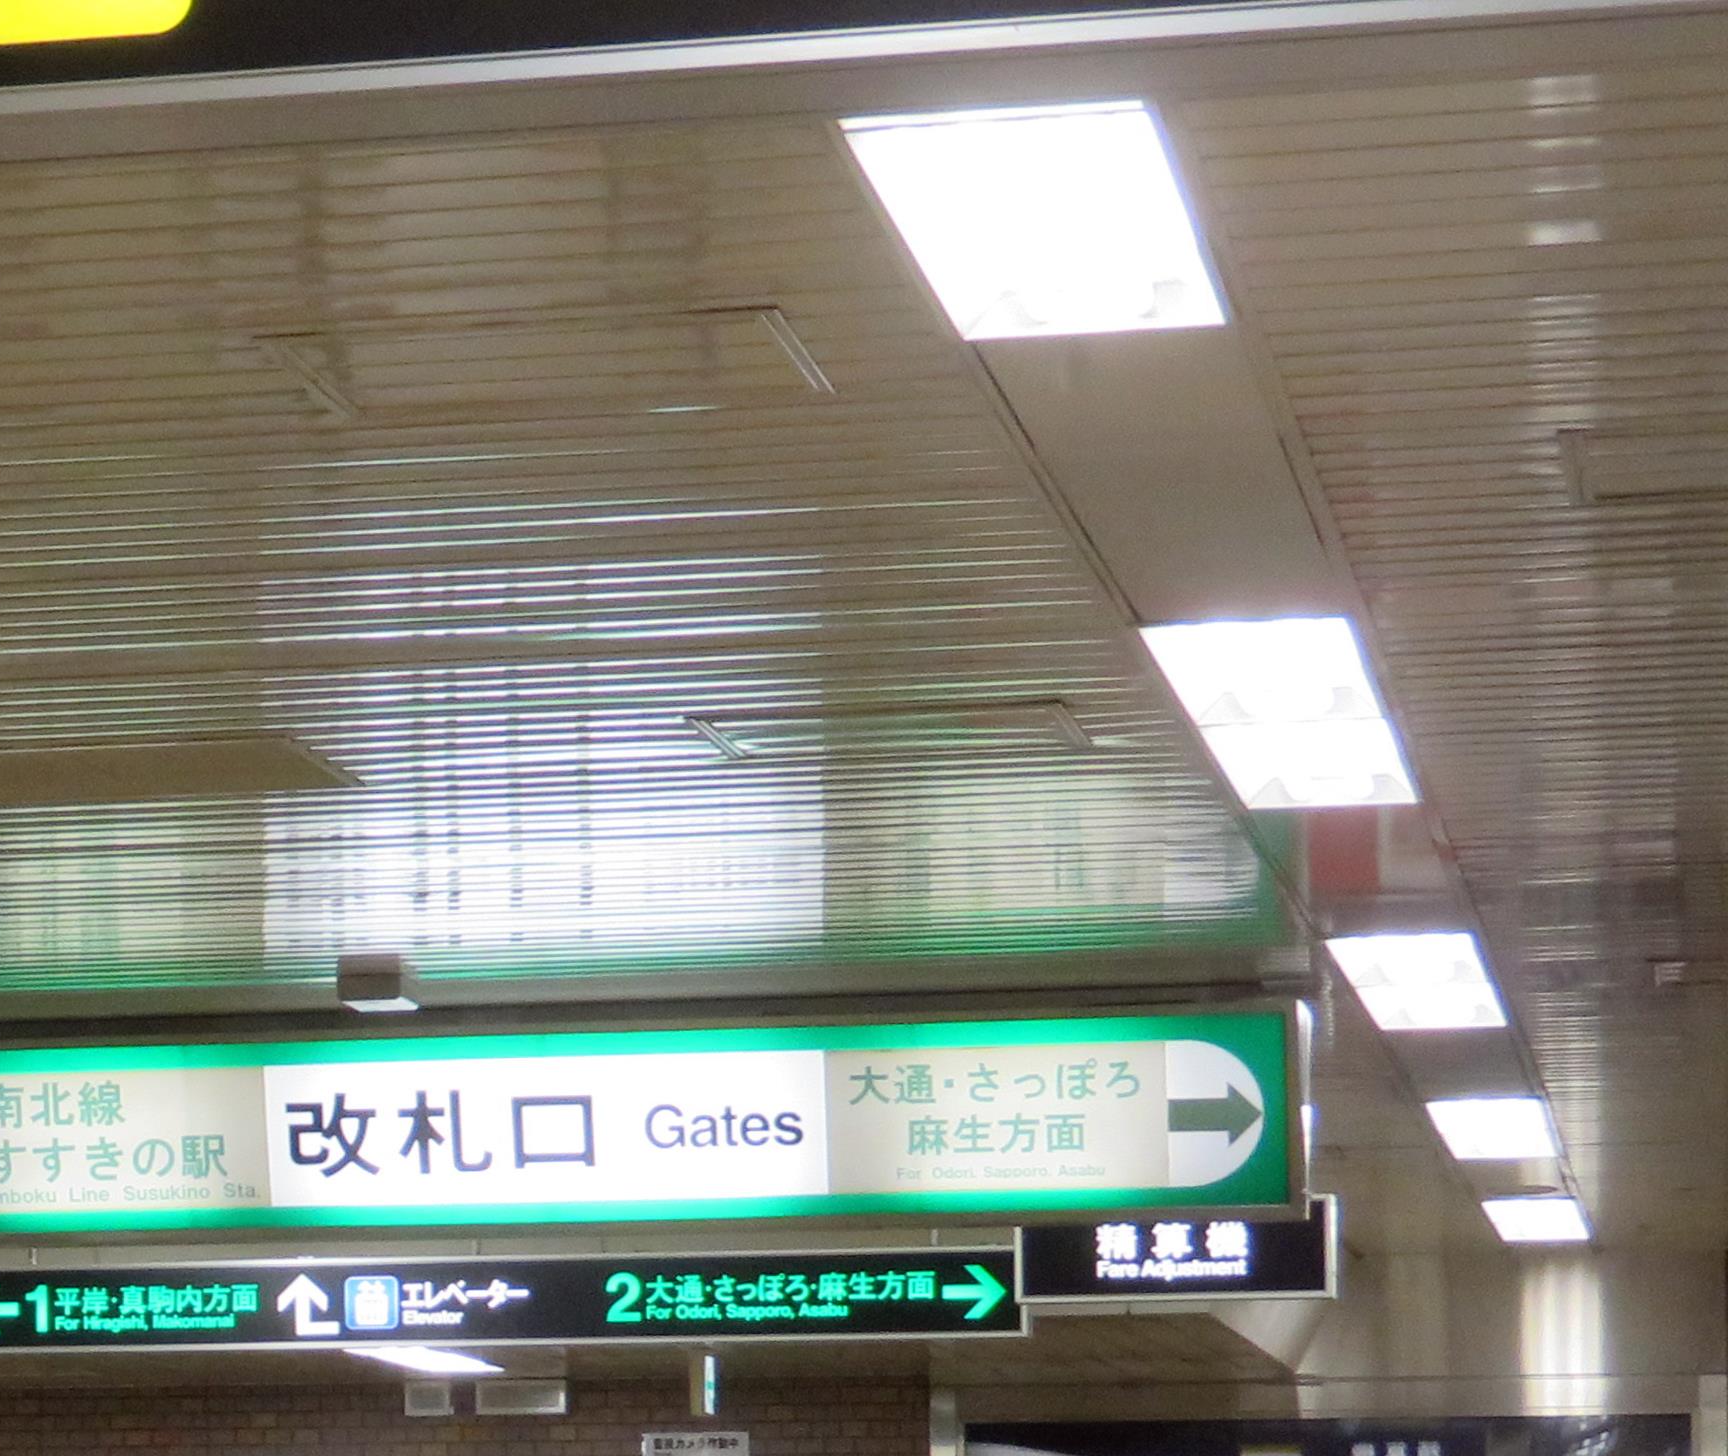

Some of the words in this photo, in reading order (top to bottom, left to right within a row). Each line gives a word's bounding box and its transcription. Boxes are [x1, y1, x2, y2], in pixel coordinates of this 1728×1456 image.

[848, 1058, 1142, 1106] 大通・さっぽろ
[284, 1088, 599, 1178] 改札口
[644, 1104, 804, 1150] Gates
[906, 1112, 1087, 1157] 麻生方面
[896, 1166, 922, 1180] For
[1057, 1162, 1107, 1178] Asabu
[68, 1186, 111, 1204] Line
[122, 1184, 212, 1202] Susukino
[222, 1182, 262, 1200] Sta.
[1095, 1259, 1141, 1279] Fare
[1141, 1258, 1249, 1282] Adjustment
[399, 1278, 531, 1310] エレベーター
[605, 1272, 642, 1323] 2
[645, 1270, 936, 1304] 大通・さっぽろ・麻生方面
[25, 1283, 49, 1334] 1
[54, 1283, 260, 1315] 平岸・真駒内方面
[401, 1309, 465, 1326] Elevator
[645, 1304, 673, 1320] For
[675, 1303, 722, 1321] Odori,
[725, 1302, 796, 1322] Sapporo,
[798, 1302, 849, 1318] Asabu
[55, 1316, 81, 1332] For
[82, 1314, 150, 1334] Hiragishi,
[151, 1312, 237, 1330] Makomanai
